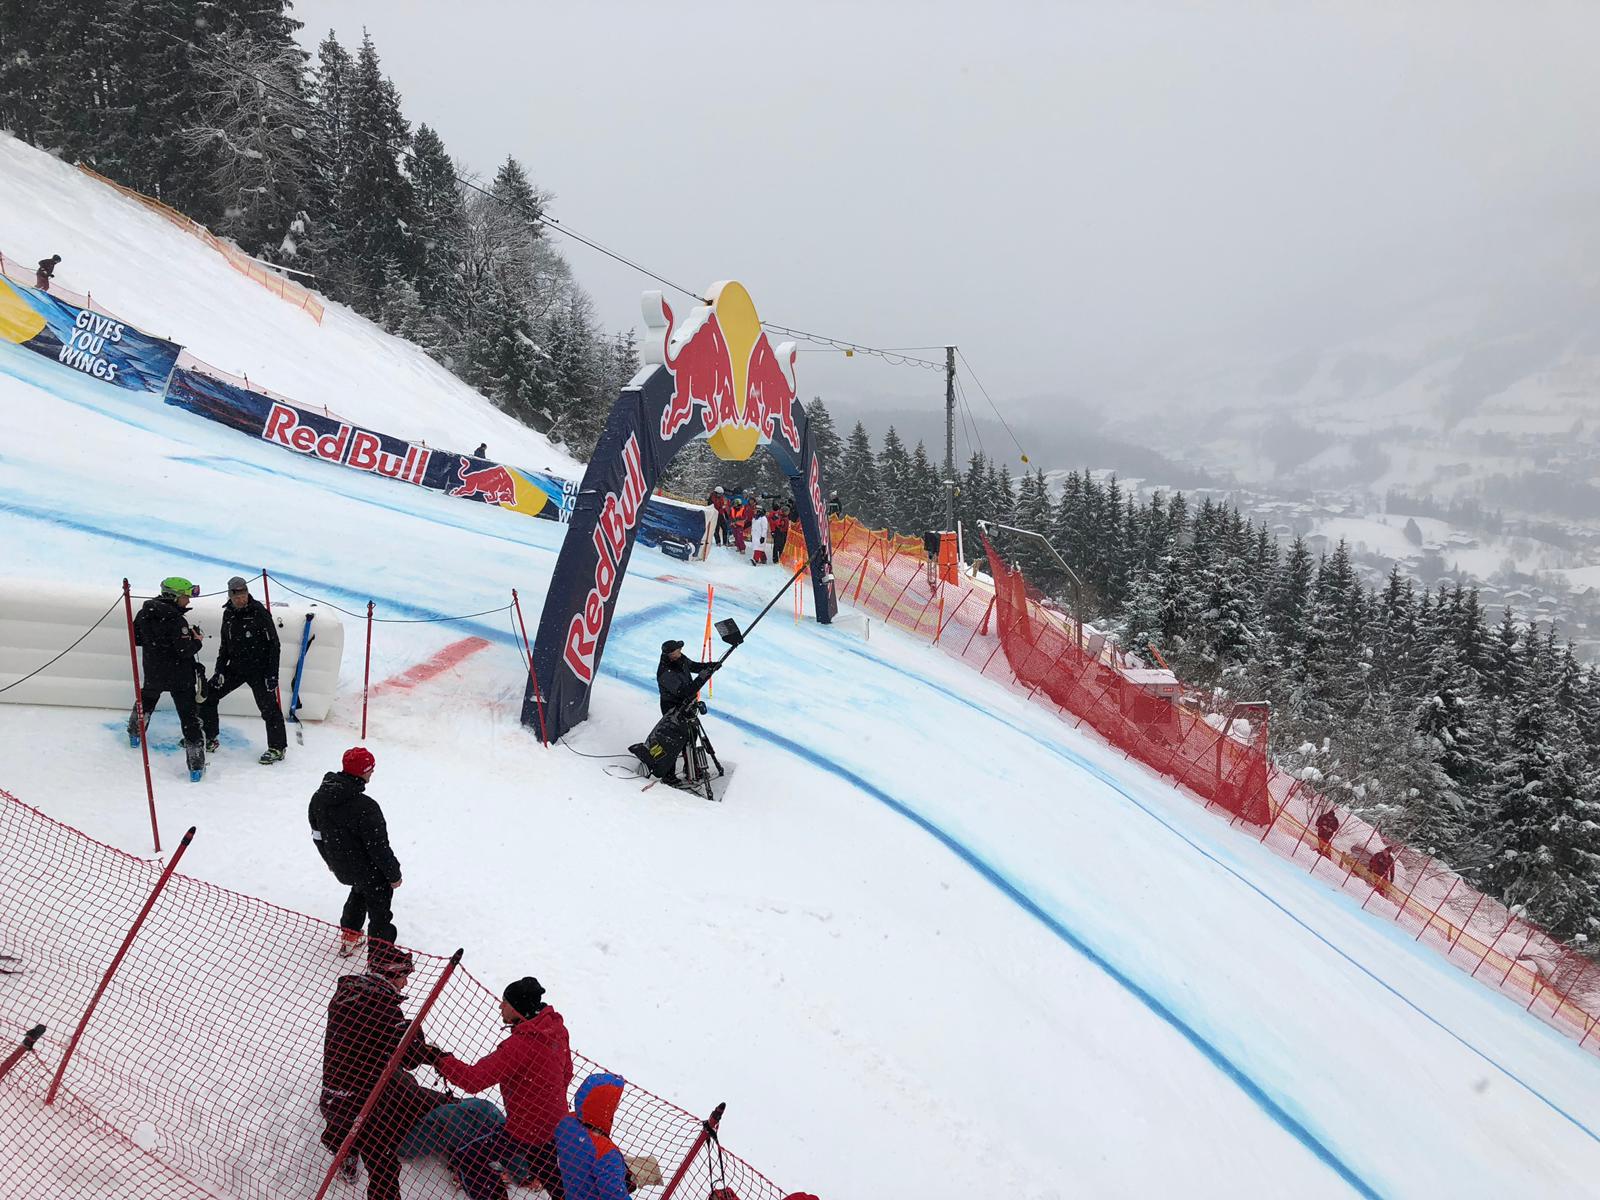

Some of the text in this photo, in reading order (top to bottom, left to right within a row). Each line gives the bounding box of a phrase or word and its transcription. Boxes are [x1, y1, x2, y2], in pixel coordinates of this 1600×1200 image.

[69, 327, 105, 355] YOU
[76, 310, 125, 342] GIVES
[59, 345, 118, 381] WINGS
[562, 493, 577, 511] YO
